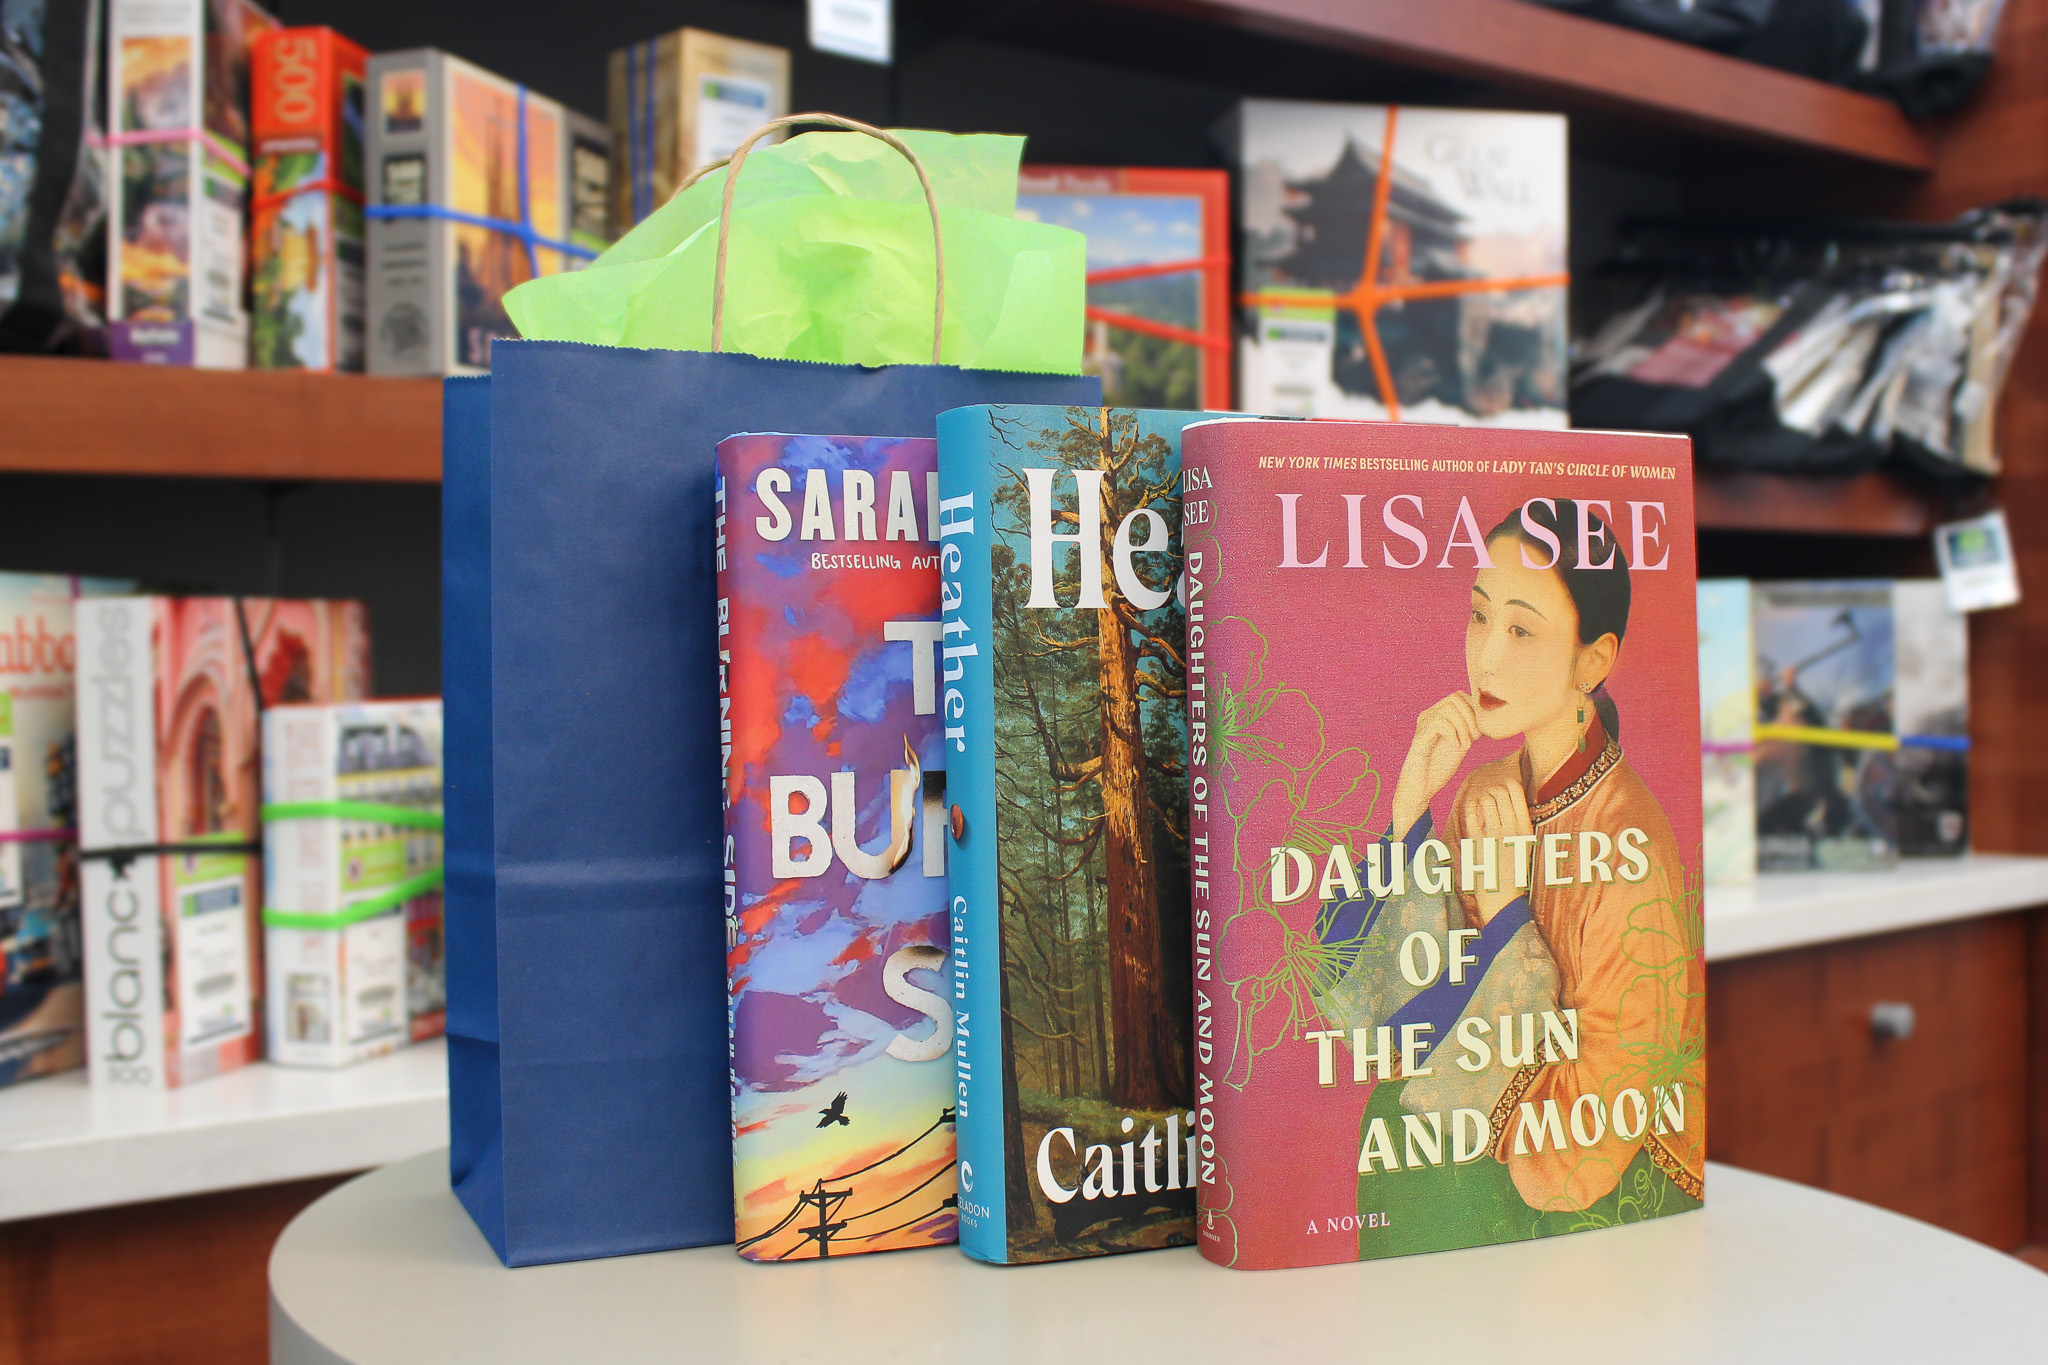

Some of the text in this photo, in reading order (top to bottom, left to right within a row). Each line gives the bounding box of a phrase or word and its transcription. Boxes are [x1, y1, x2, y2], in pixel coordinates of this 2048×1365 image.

[274, 37, 317, 124] 500
[1183, 466, 1213, 493] LISA
[1258, 456, 1676, 480] NEW YORK TIMES BESTSELLING AUTHOR OF LADY TAN'S CIRCLE OF WOMEN
[1022, 468, 1185, 611] He
[1184, 500, 1209, 526] SEE
[1275, 494, 1670, 570] LISA SEE
[810, 552, 901, 570] BESTSELLING
[939, 491, 978, 753] Heather
[90, 603, 147, 838] puzzles
[715, 475, 727, 574] THE
[724, 834, 738, 949] SIDE
[1188, 551, 1216, 1185] DAUGHTERS OF THE SUN AND MOON
[1270, 827, 1650, 903] DAUGHTERS
[102, 888, 144, 1063] blanc
[1399, 928, 1480, 987] OF
[953, 895, 972, 1118] Caitlin Mullen
[1304, 1008, 1579, 1085] THE SUN
[1036, 1110, 1196, 1204] Caitli
[1357, 1082, 1686, 1173] AND MOON
[1306, 1211, 1391, 1235] A NOVEL
